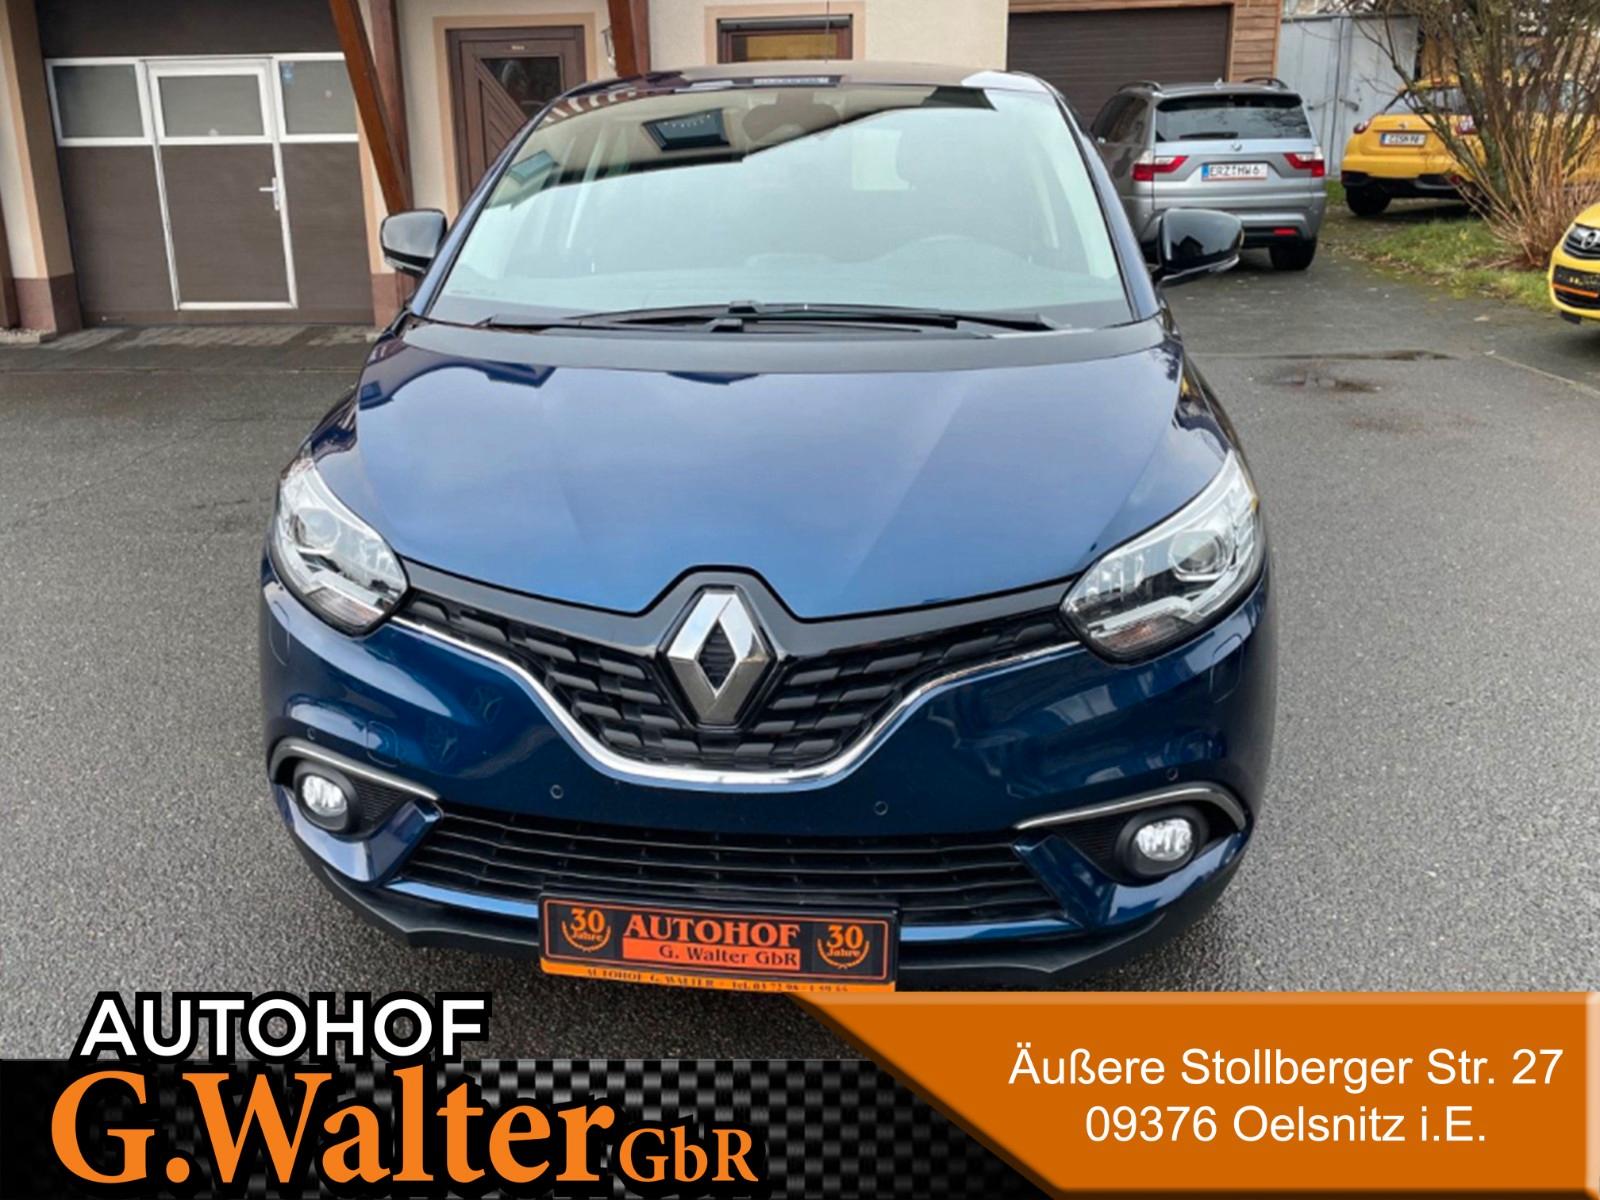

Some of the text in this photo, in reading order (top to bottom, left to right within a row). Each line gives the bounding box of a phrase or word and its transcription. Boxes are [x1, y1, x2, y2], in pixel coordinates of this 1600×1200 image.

[570, 907, 605, 934] 30
[623, 913, 801, 948] AUTOHOF
[827, 924, 864, 950] 30
[658, 944, 799, 967] G. Walter GbR
